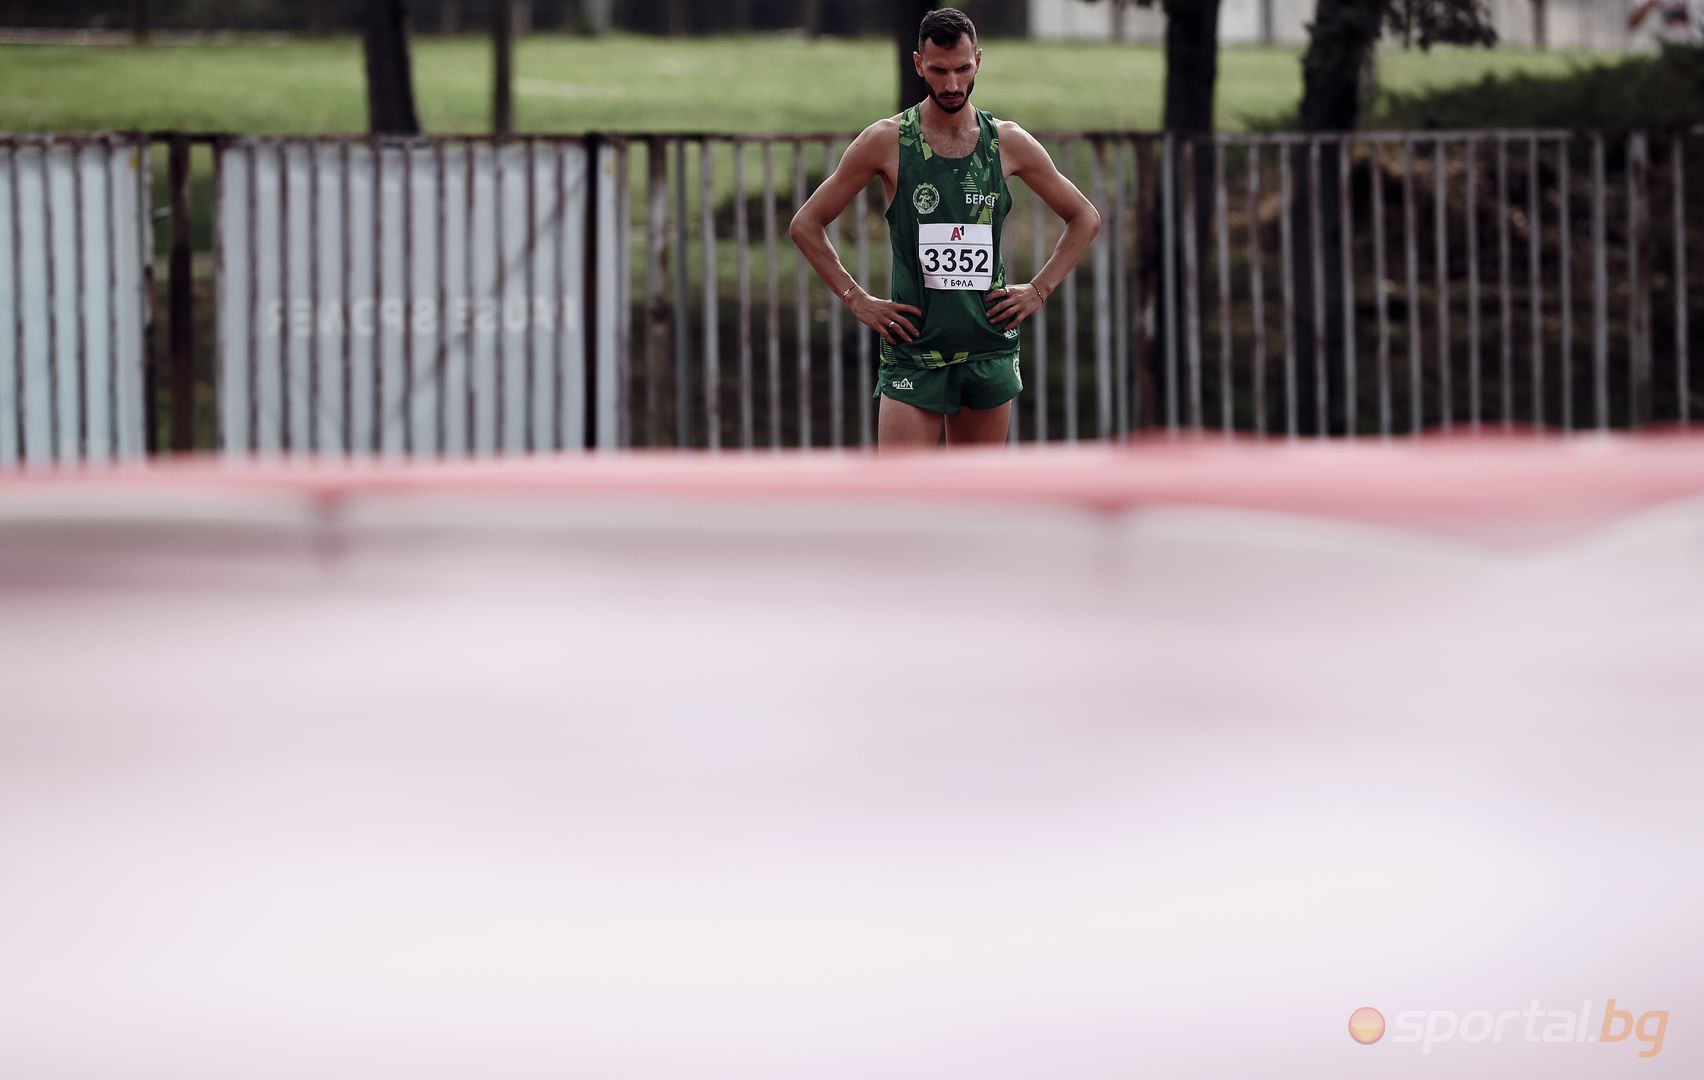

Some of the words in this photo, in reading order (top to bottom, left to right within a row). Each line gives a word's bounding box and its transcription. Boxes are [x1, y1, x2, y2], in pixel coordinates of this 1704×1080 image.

[950, 225, 965, 241] A1
[924, 248, 989, 273] 3352
[950, 279, 974, 288] БФЛА
